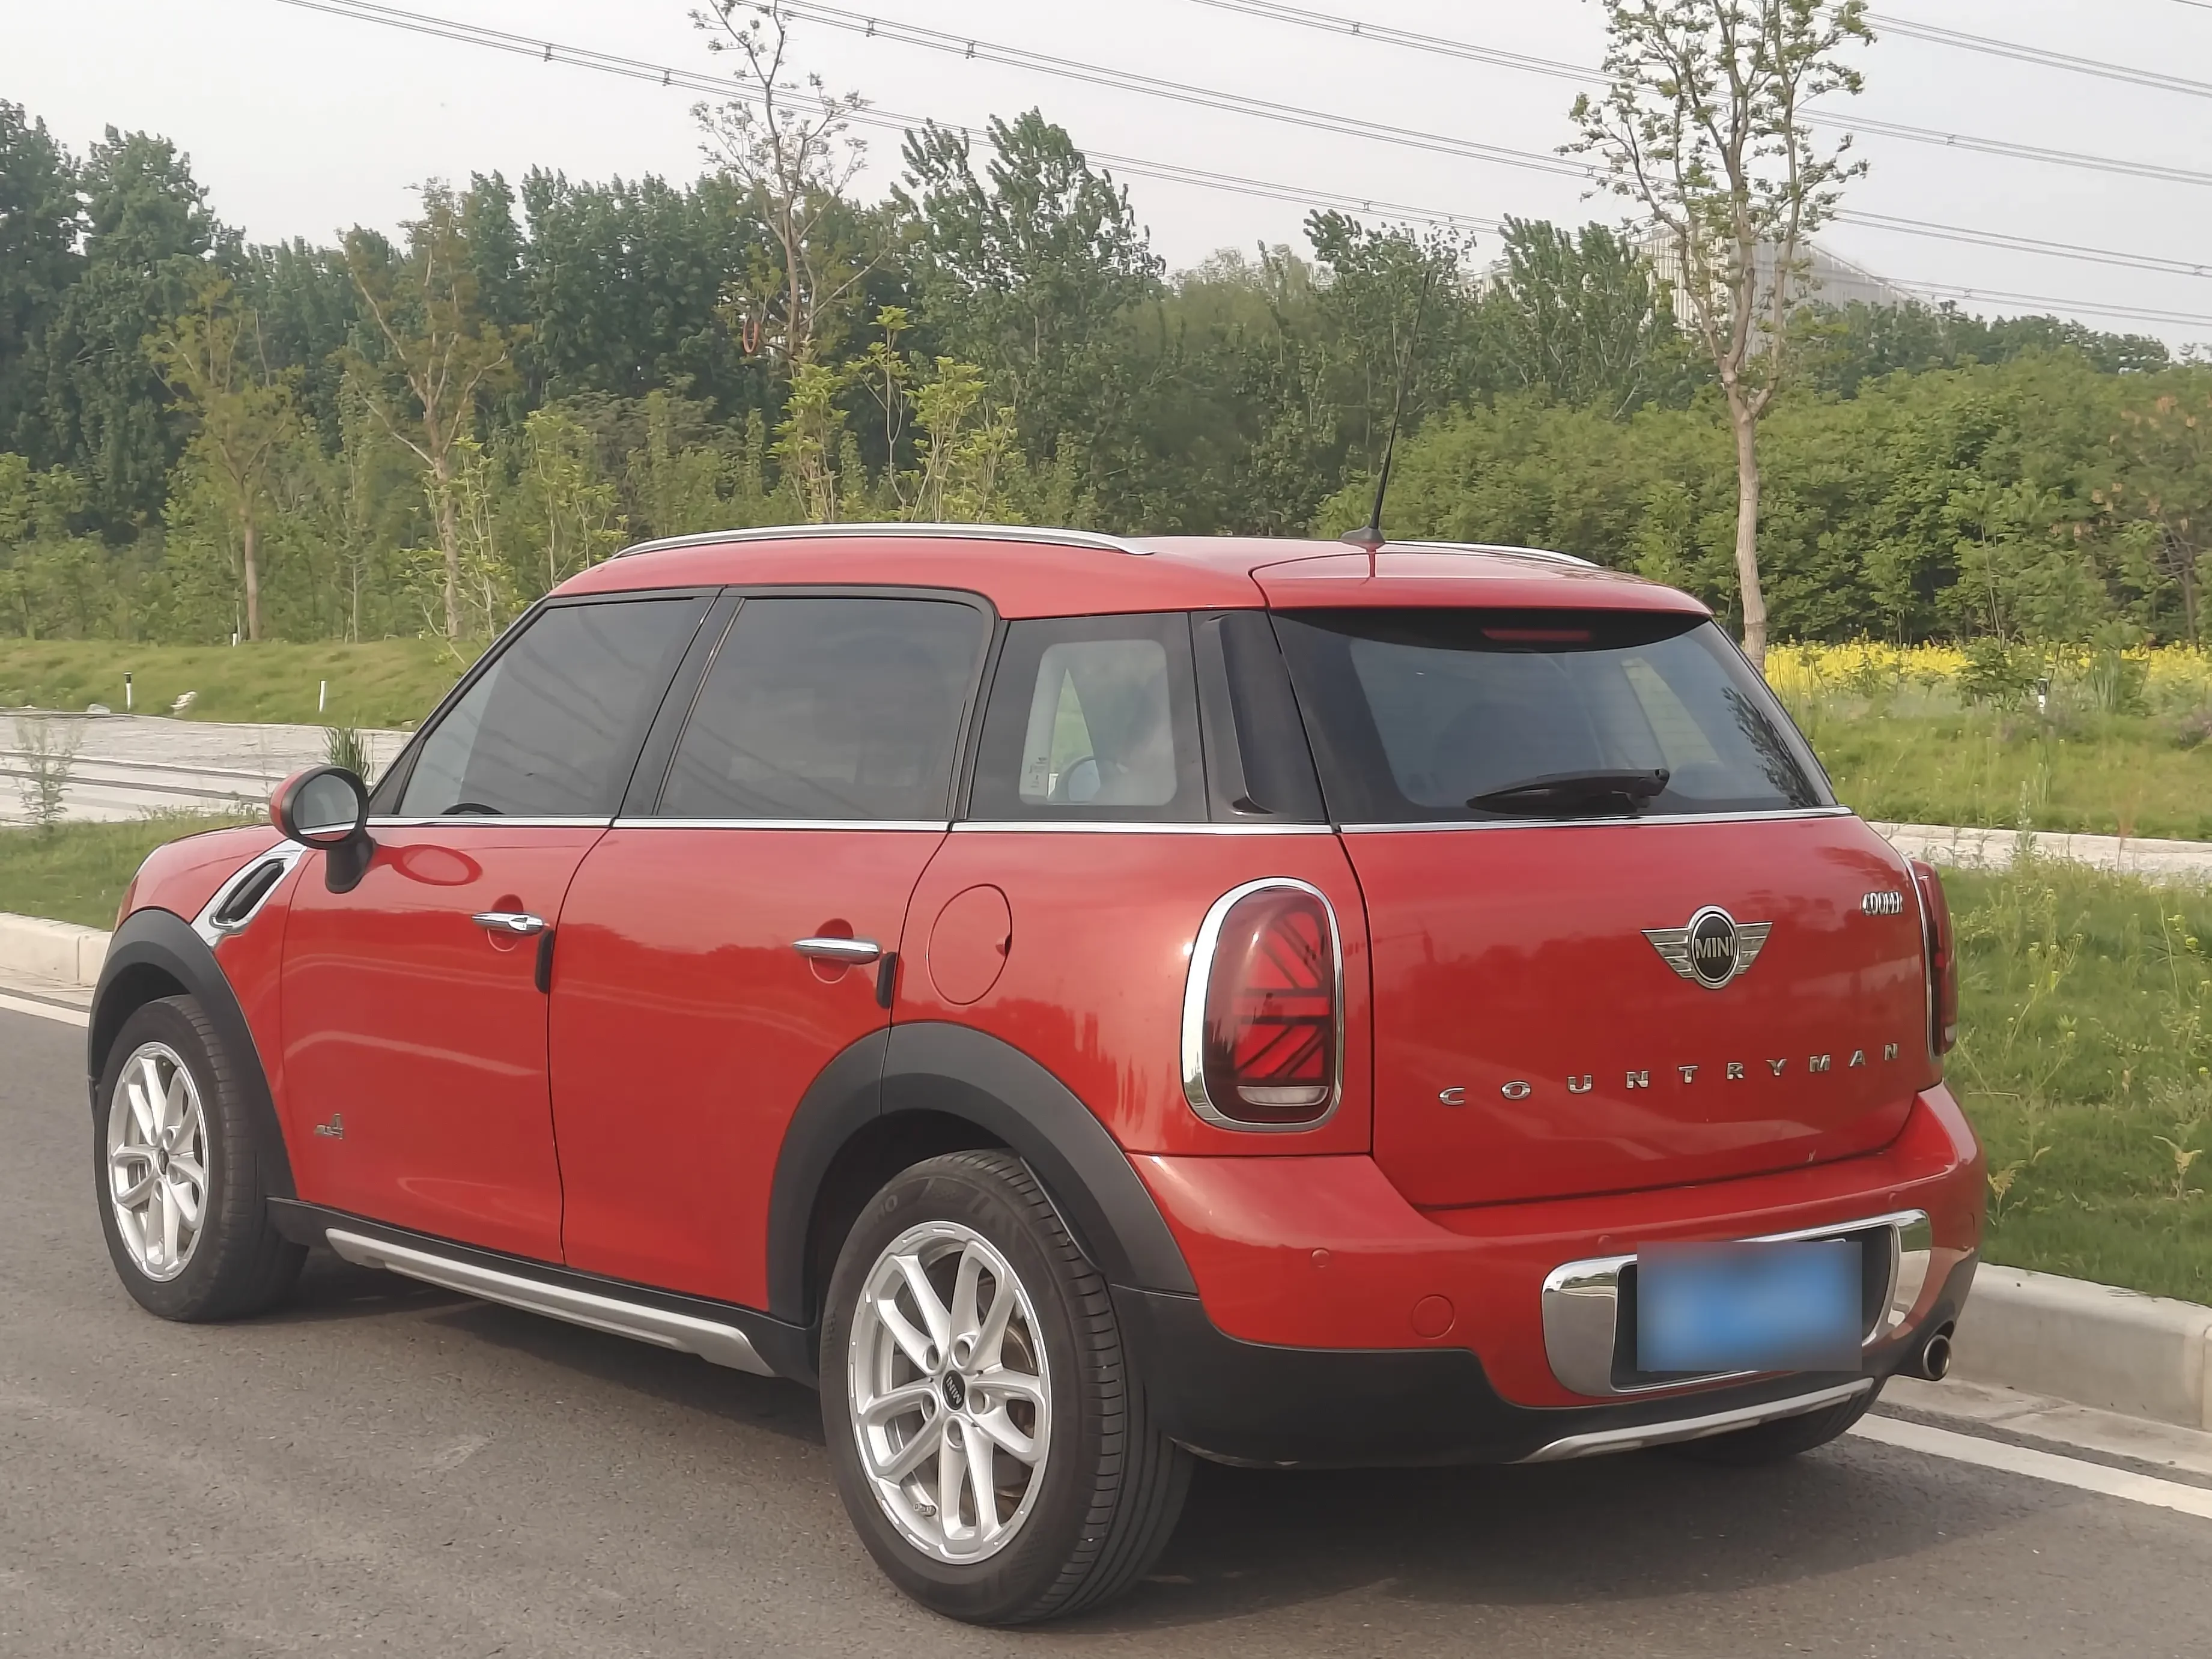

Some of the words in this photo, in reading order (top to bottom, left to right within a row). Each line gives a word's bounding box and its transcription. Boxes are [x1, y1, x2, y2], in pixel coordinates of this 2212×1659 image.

[1695, 935, 1734, 959] MINI
[1439, 1043, 1898, 1106] COUNTRYMAN
[946, 1375, 962, 1404] MINI
